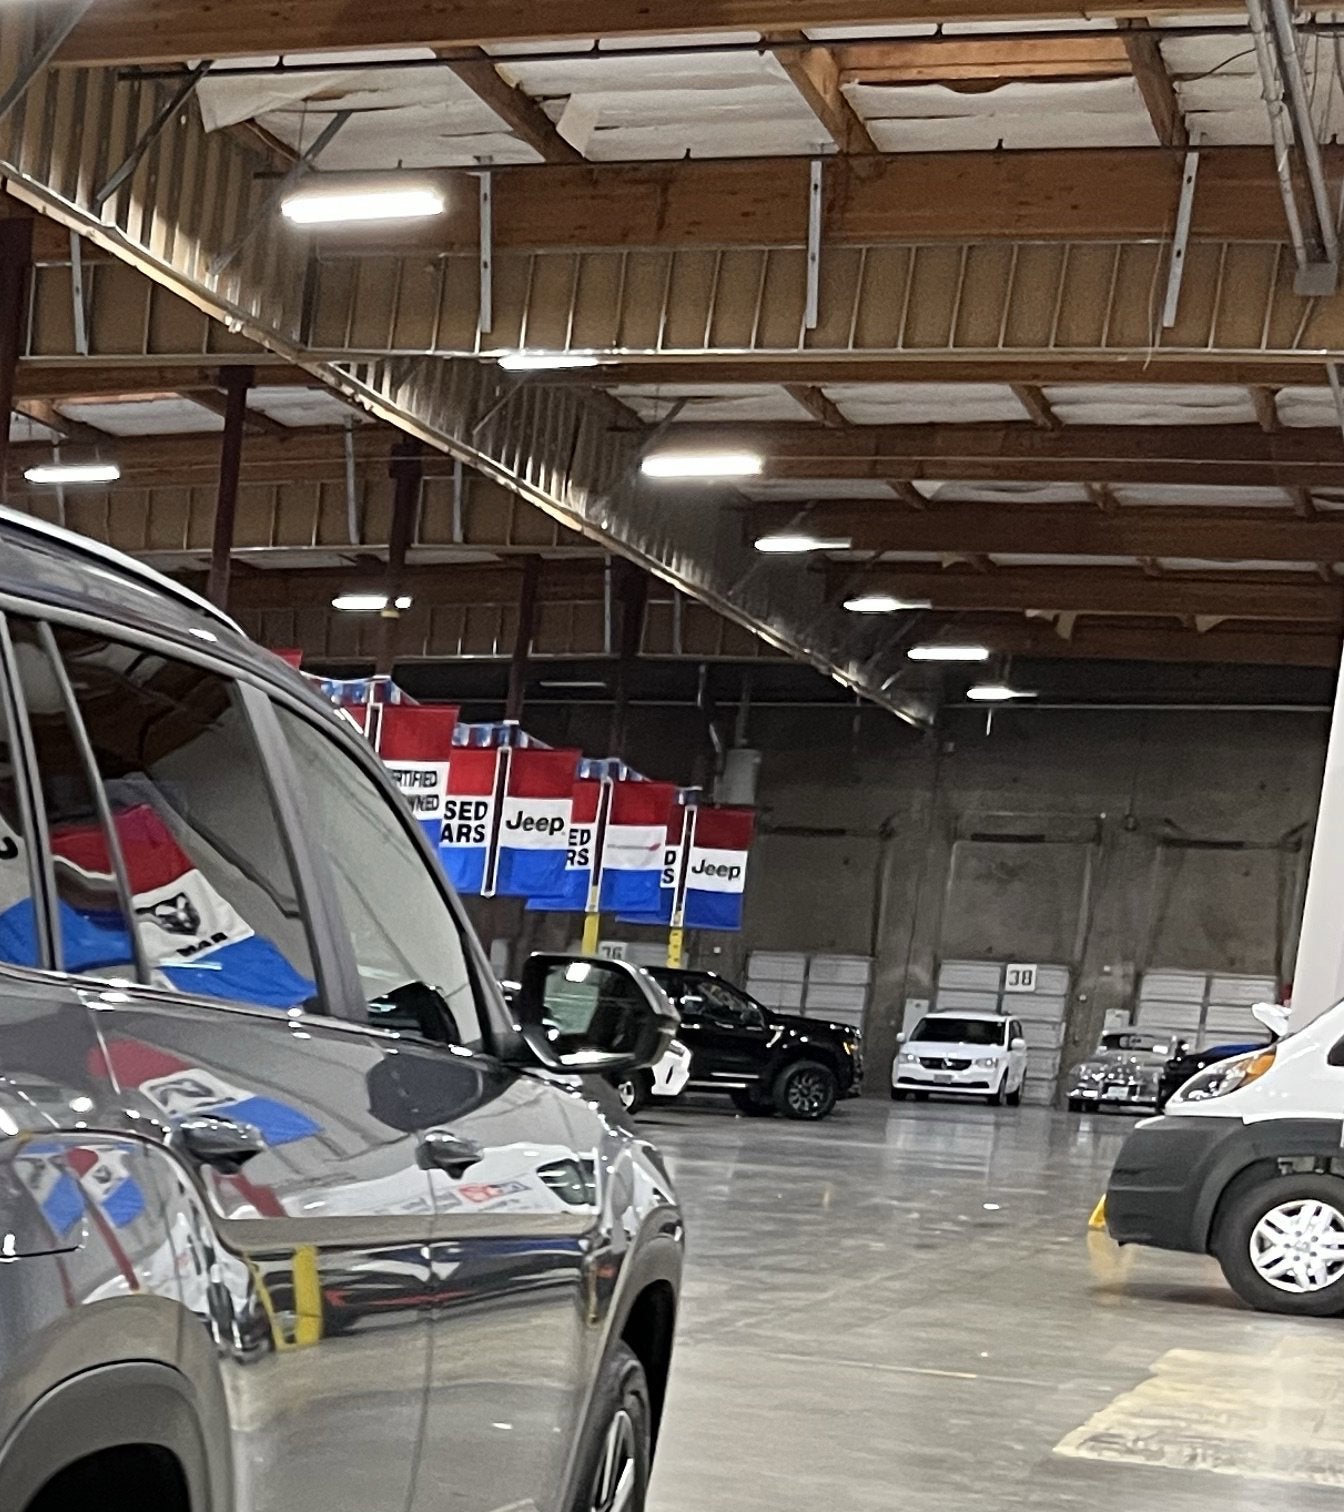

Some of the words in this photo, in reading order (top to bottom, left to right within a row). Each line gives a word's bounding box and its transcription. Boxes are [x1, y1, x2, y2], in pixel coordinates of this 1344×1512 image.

[444, 800, 488, 821] SED
[506, 810, 565, 835] Jeep
[440, 823, 486, 843] ARS
[569, 828, 591, 846] ED
[567, 849, 589, 866] RS
[692, 859, 741, 881] Jeep
[1009, 970, 1033, 986] 38
